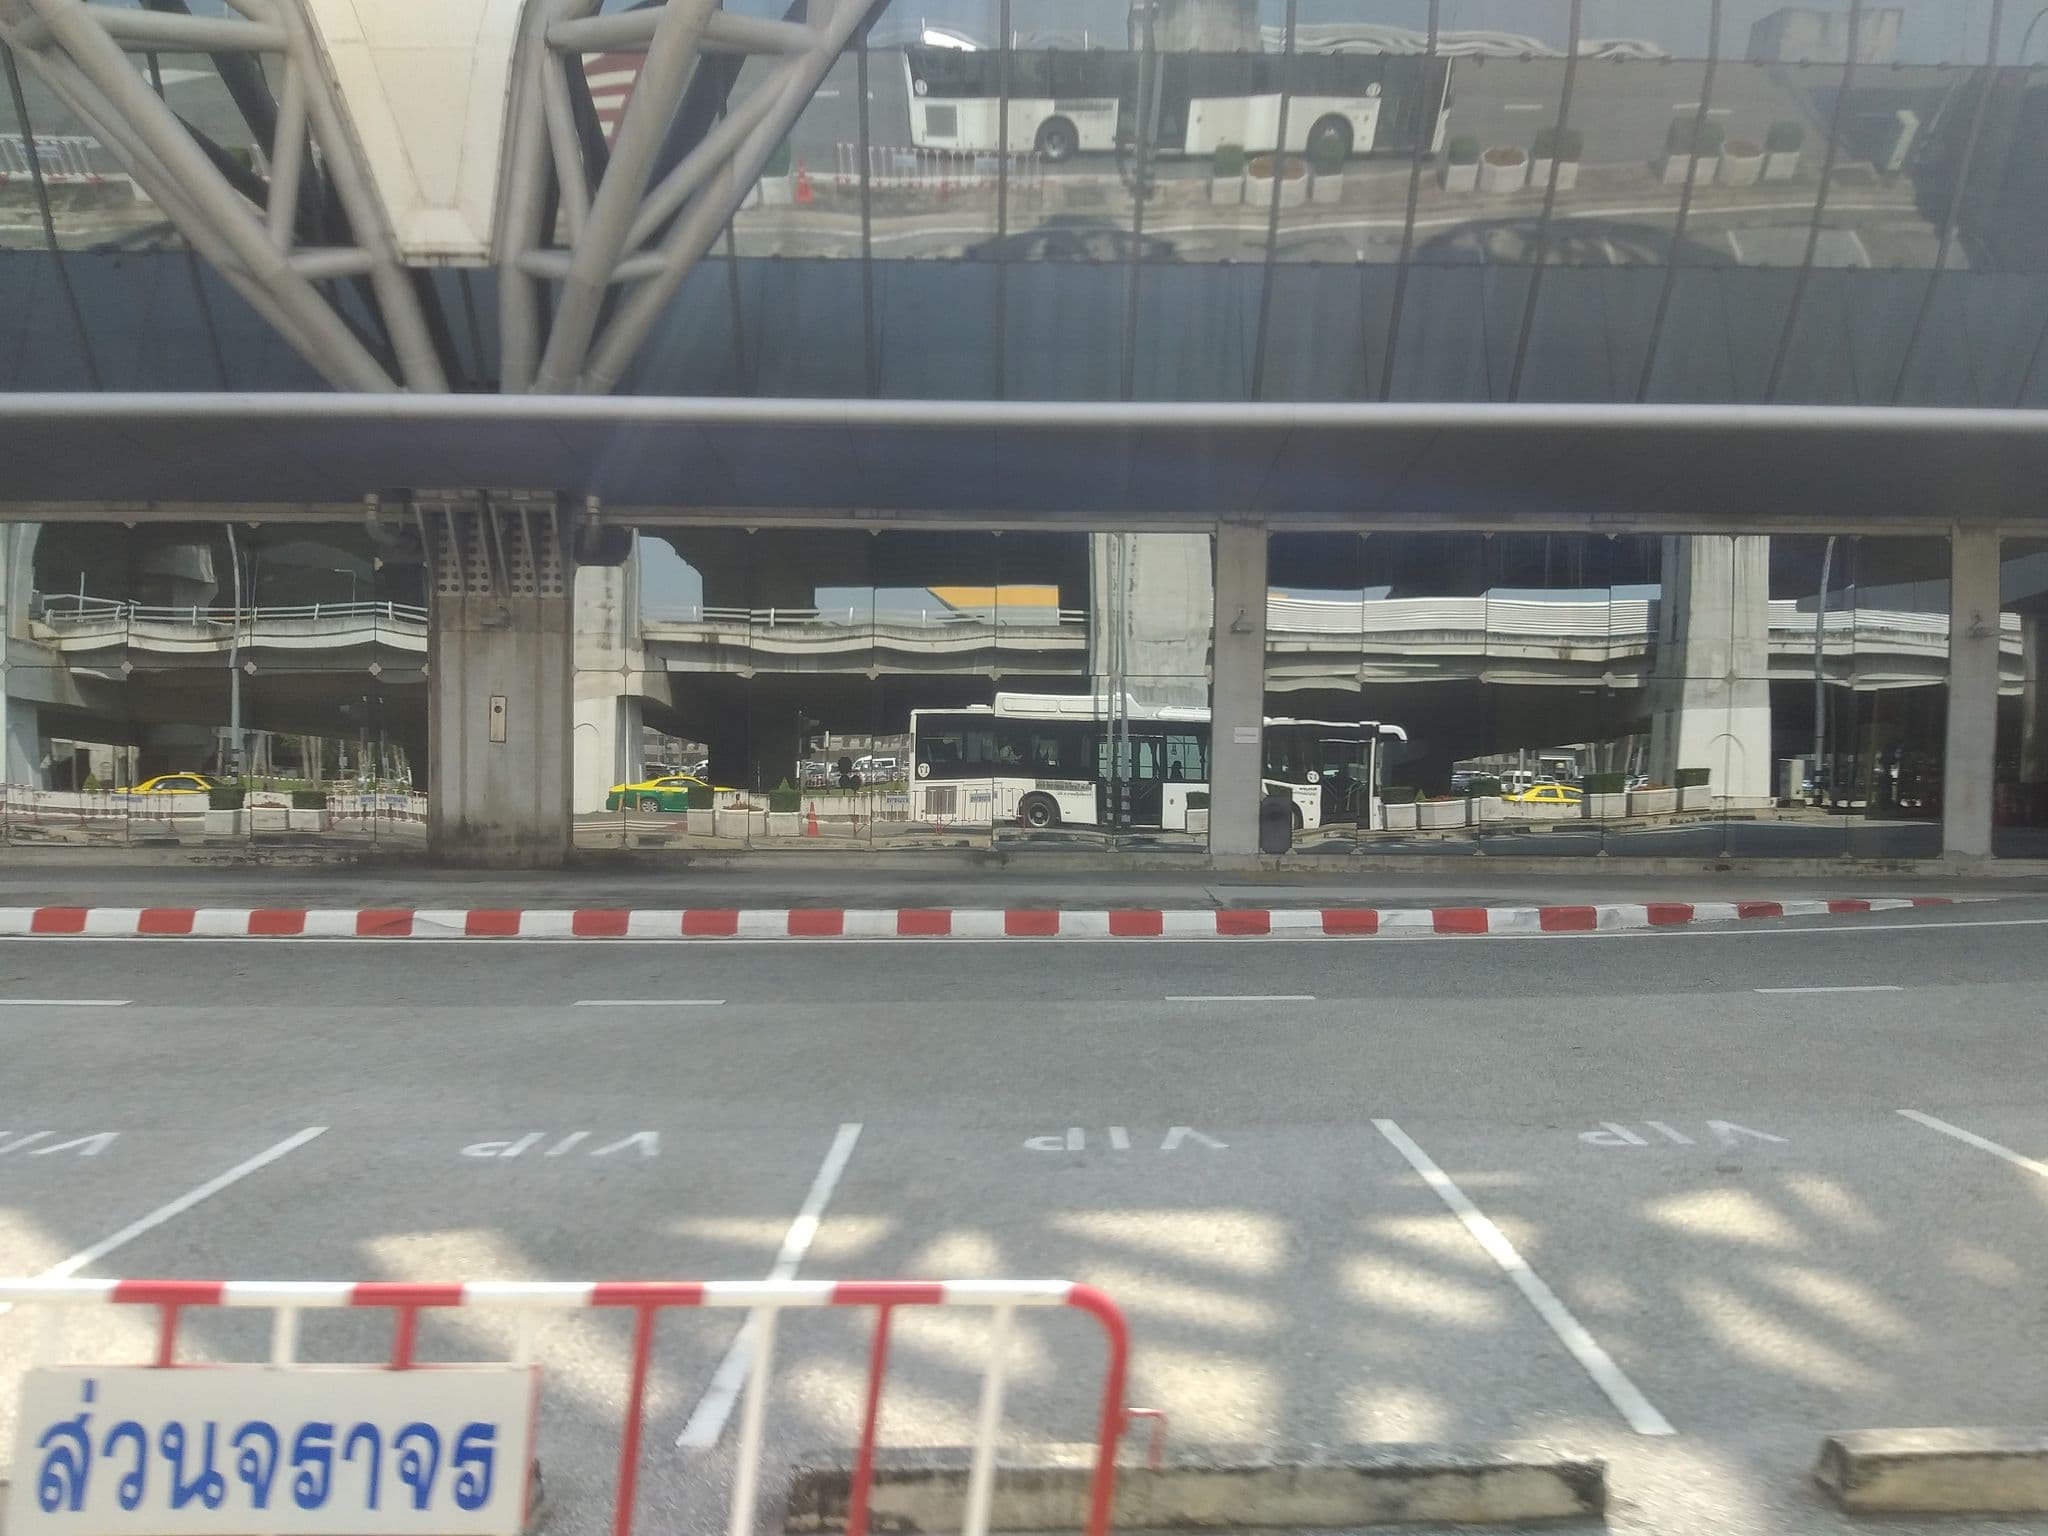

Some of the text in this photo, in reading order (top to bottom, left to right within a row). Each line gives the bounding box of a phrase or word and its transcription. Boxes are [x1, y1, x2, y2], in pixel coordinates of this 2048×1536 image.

[0, 1131, 120, 1155] VI
[461, 1131, 661, 1157] VIP
[1024, 1127, 1230, 1151] VIP
[1578, 1120, 1790, 1145] VIP
[37, 1379, 497, 1513] ส่วนจราจร
